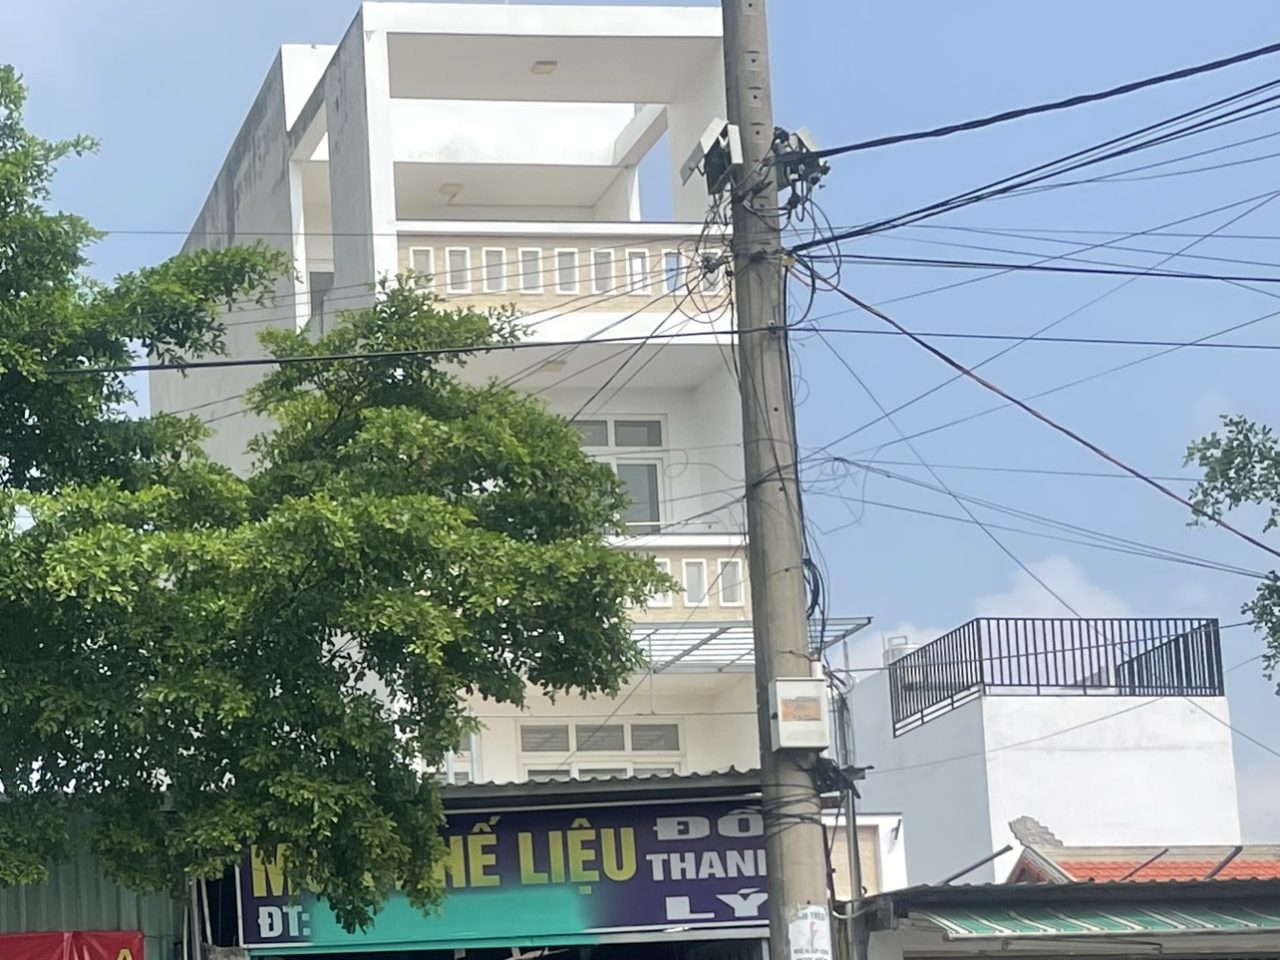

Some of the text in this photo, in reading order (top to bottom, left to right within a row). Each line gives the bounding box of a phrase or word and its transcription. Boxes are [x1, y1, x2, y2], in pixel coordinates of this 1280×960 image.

[518, 817, 637, 895] LIỆU
[665, 888, 769, 920] LÝ
[257, 905, 312, 938] ĐT:
